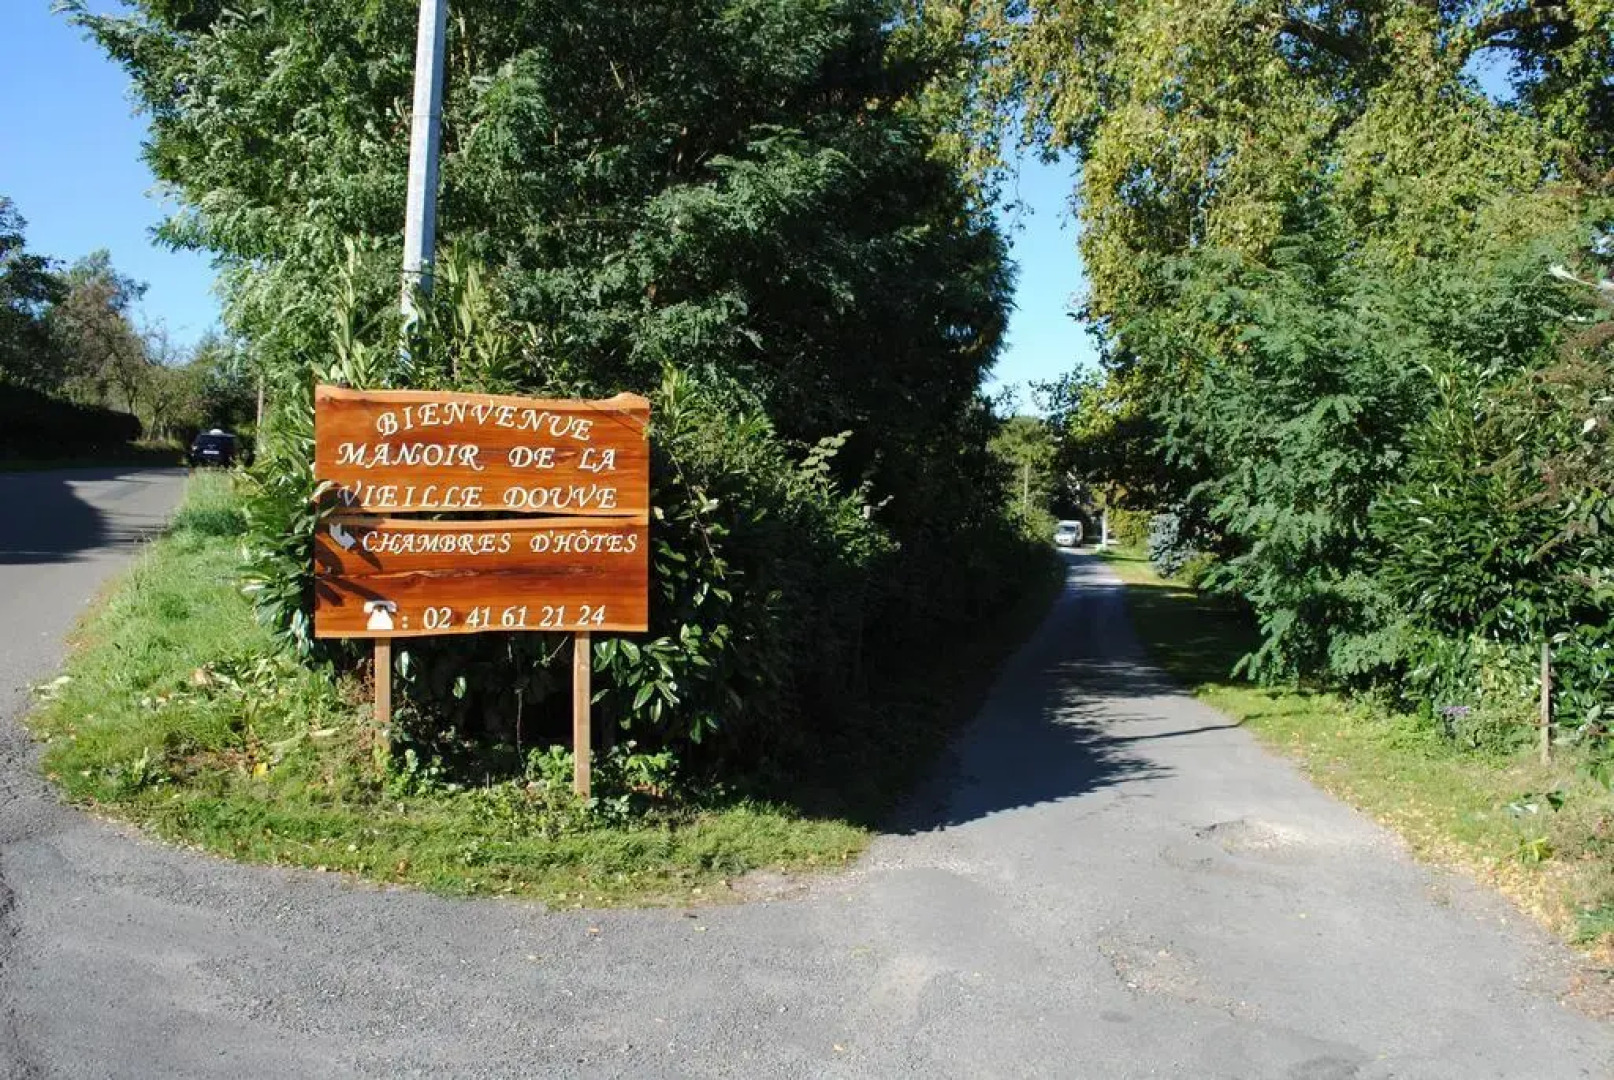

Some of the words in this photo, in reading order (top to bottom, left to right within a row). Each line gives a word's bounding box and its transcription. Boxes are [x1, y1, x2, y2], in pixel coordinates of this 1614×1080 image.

[376, 400, 593, 441] BIENVENUE
[336, 442, 484, 471] MANOIR
[508, 446, 555, 469] DE
[578, 447, 616, 473] LA
[337, 480, 483, 508] VIEILLE
[503, 484, 618, 508] DOUVE
[362, 531, 511, 555] CHAMBRES
[530, 529, 638, 553] D'HÔTES
[423, 606, 452, 630] 02
[466, 606, 491, 629] 41
[502, 605, 527, 629] 61
[540, 605, 565, 628] 21
[577, 605, 606, 627] 24
